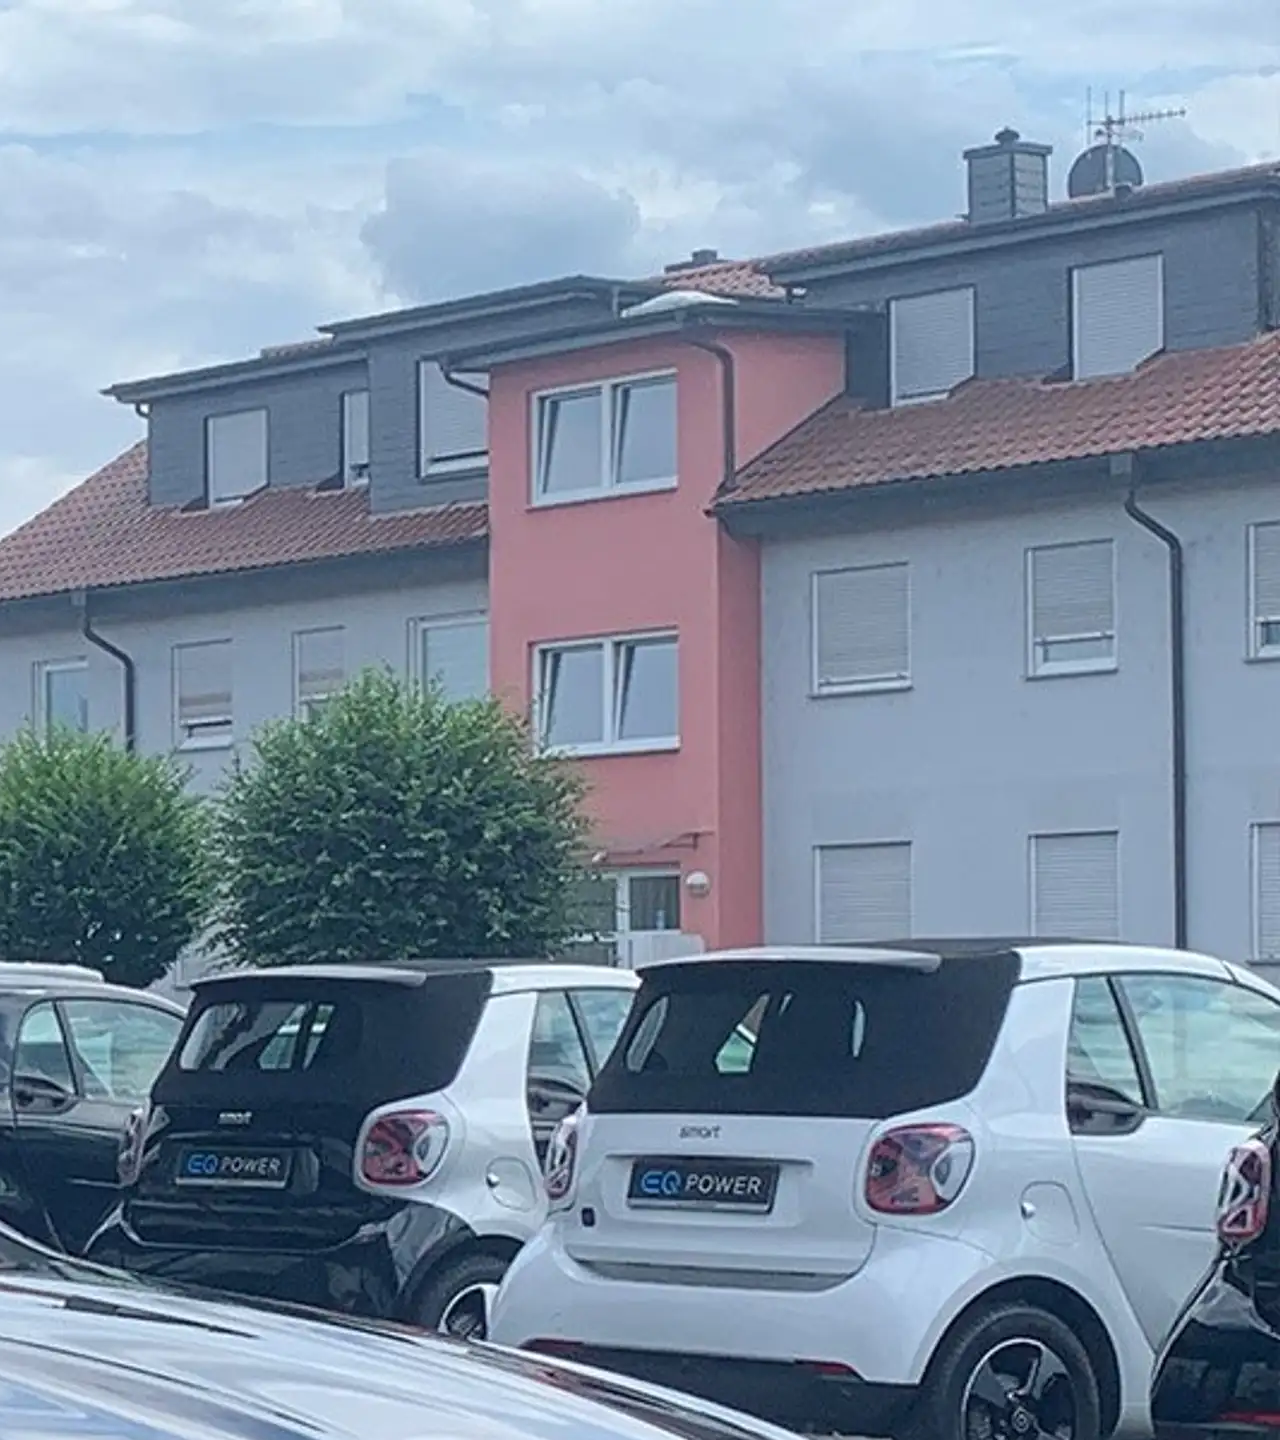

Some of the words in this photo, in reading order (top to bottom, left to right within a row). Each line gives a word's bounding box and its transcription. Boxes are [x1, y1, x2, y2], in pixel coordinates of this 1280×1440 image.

[679, 1125, 721, 1139] smart
[187, 1154, 219, 1175] EQ
[221, 1156, 281, 1176] POWER
[641, 1170, 681, 1195] EQ
[685, 1173, 762, 1195] POWER
